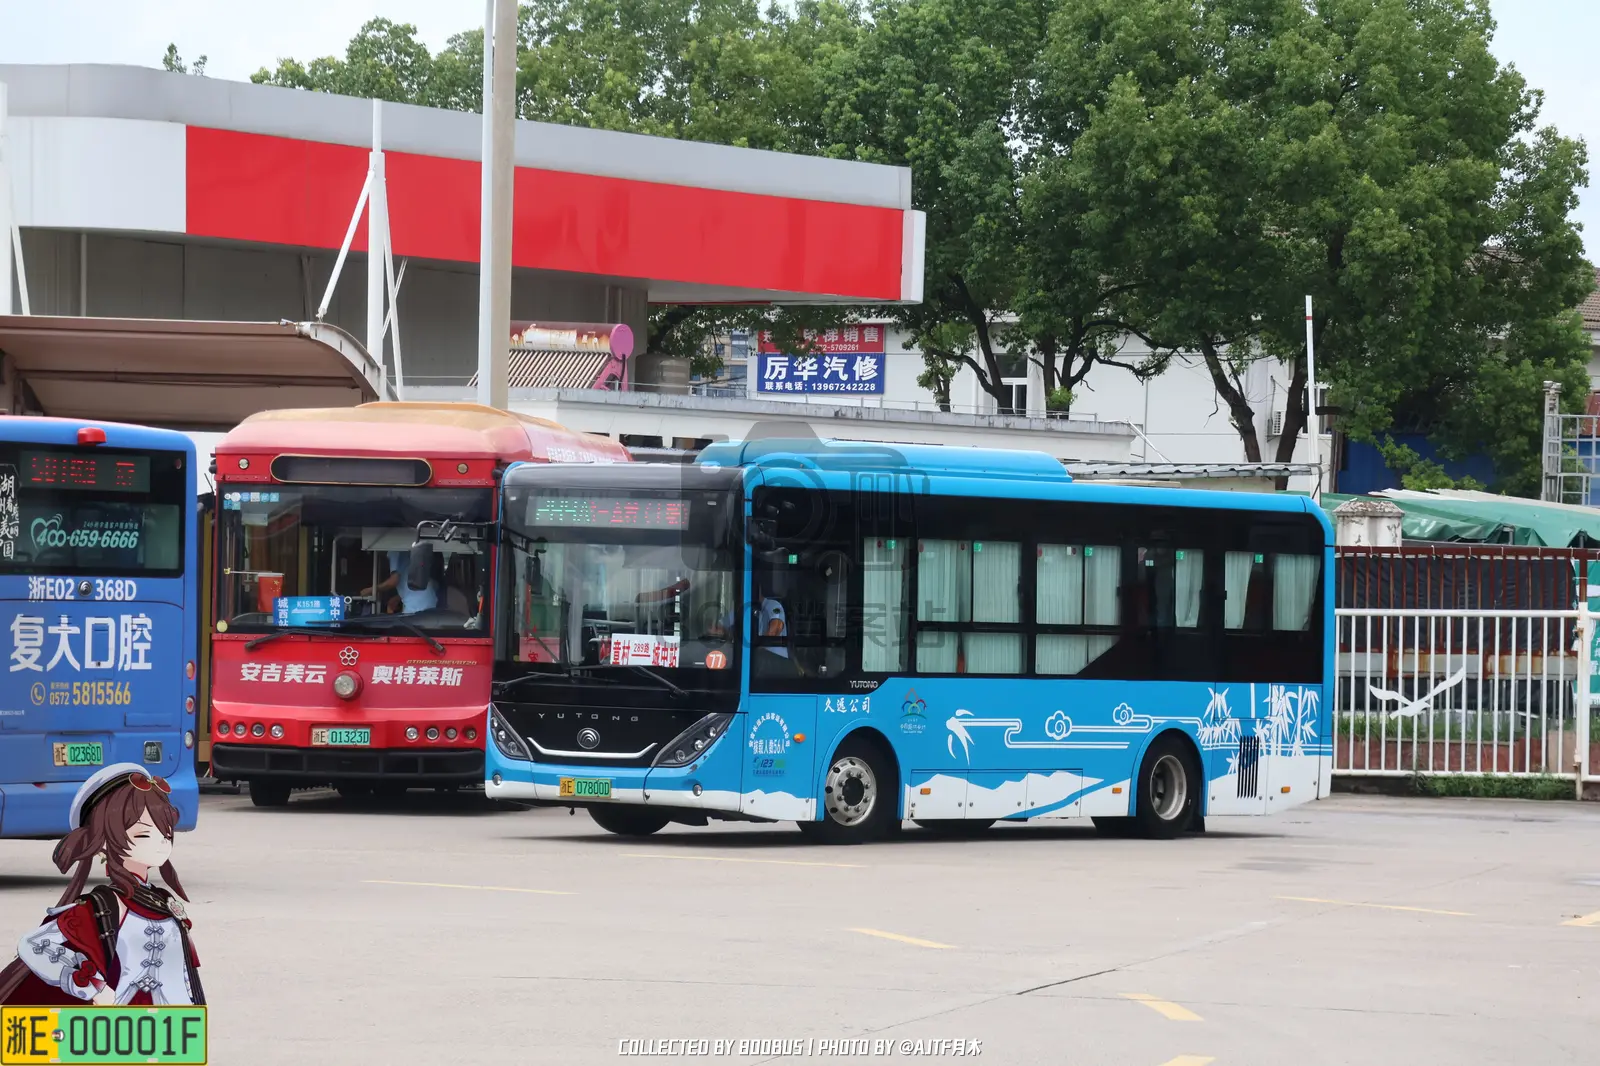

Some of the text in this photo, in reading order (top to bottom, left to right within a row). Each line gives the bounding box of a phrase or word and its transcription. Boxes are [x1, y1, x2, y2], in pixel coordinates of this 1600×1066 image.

[764, 356, 879, 381] 厉华汽修
[36, 527, 140, 549] 400-659-6666
[28, 576, 137, 602] 浙E02 368D
[10, 613, 152, 672] 复大口腔
[709, 654, 723, 668] 77
[240, 663, 327, 683] 安吉美云
[371, 666, 463, 687] 奥特莱斯
[50, 692, 69, 705] 0572
[73, 682, 131, 705] 5815566
[538, 712, 638, 722] YUTONG
